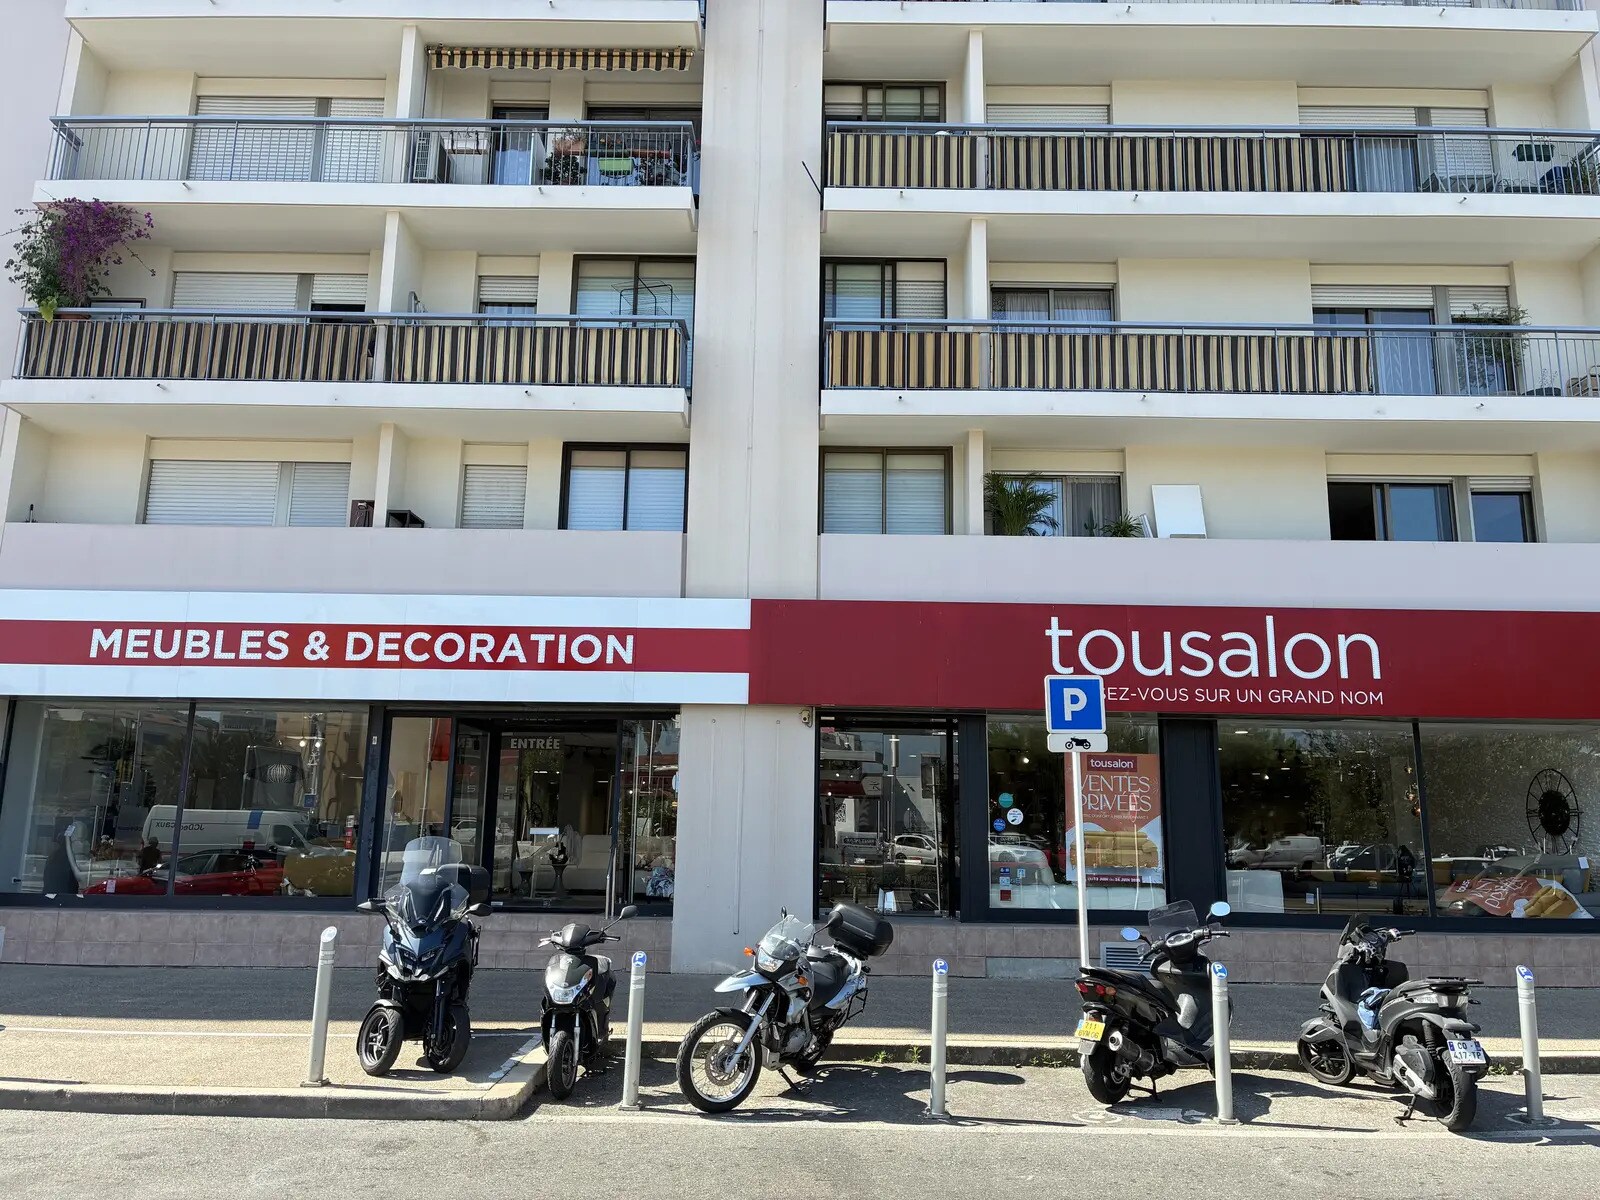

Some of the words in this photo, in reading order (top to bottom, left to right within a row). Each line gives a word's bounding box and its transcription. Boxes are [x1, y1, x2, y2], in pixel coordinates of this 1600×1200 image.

[89, 628, 290, 660] MEUBLES
[303, 630, 330, 661] &
[345, 631, 634, 665] DECORATION
[1045, 614, 1381, 679] tousalon
[1063, 687, 1088, 721] P
[1195, 688, 1230, 703] SUR
[1236, 690, 1262, 703] UN
[1268, 690, 1334, 704] GRAND
[1340, 691, 1383, 705] NOM
[510, 736, 560, 750] ENTRÉE
[1090, 759, 1134, 769] tousalon
